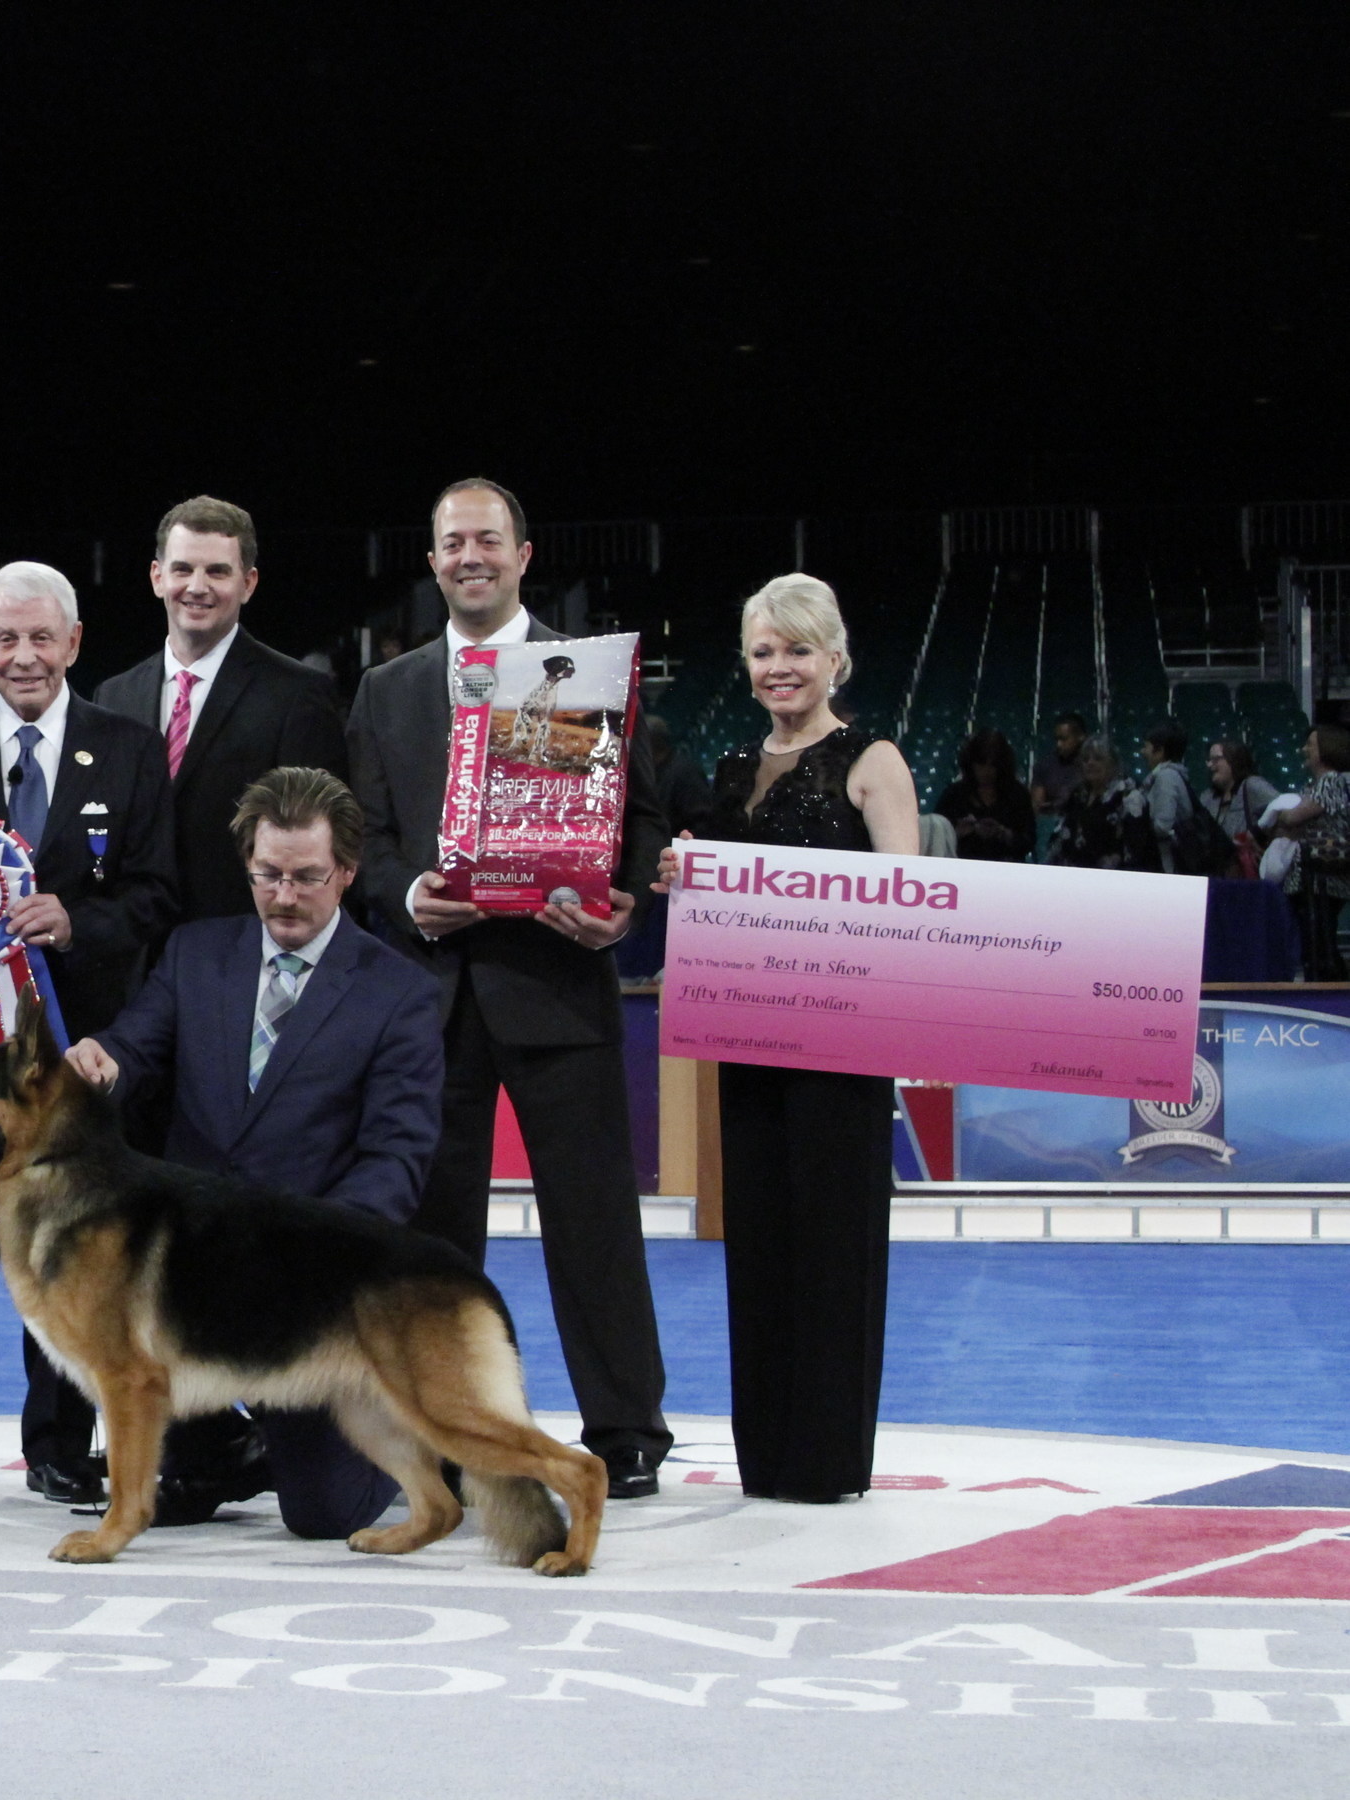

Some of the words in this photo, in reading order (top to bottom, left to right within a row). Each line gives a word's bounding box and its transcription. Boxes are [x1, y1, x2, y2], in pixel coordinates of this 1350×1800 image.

[450, 714, 480, 836] Eukanuba
[521, 830, 598, 842] PERFORMANCE
[477, 873, 534, 883] PREMIUM
[682, 851, 959, 911] Eukanuba
[681, 907, 830, 935] AKC/Eukanuba
[834, 919, 928, 943] National
[927, 926, 1063, 957] Championship
[678, 957, 692, 966] Pay
[695, 958, 703, 966] To
[706, 959, 719, 968] The
[722, 960, 742, 970] Order
[745, 962, 755, 970] Of
[763, 955, 799, 972] Best
[804, 958, 821, 973] in
[825, 960, 871, 977] Show
[678, 985, 718, 1001] Fifty
[723, 988, 801, 1007] Thousand
[801, 995, 859, 1012] Dollars
[1092, 981, 1185, 1004] $50,000.00
[705, 1033, 803, 1050] Congratulations
[1143, 1027, 1177, 1040] 00/100
[1202, 1027, 1247, 1044] THE
[1254, 1023, 1320, 1047] AKC
[1030, 1061, 1104, 1079] Eukanuba
